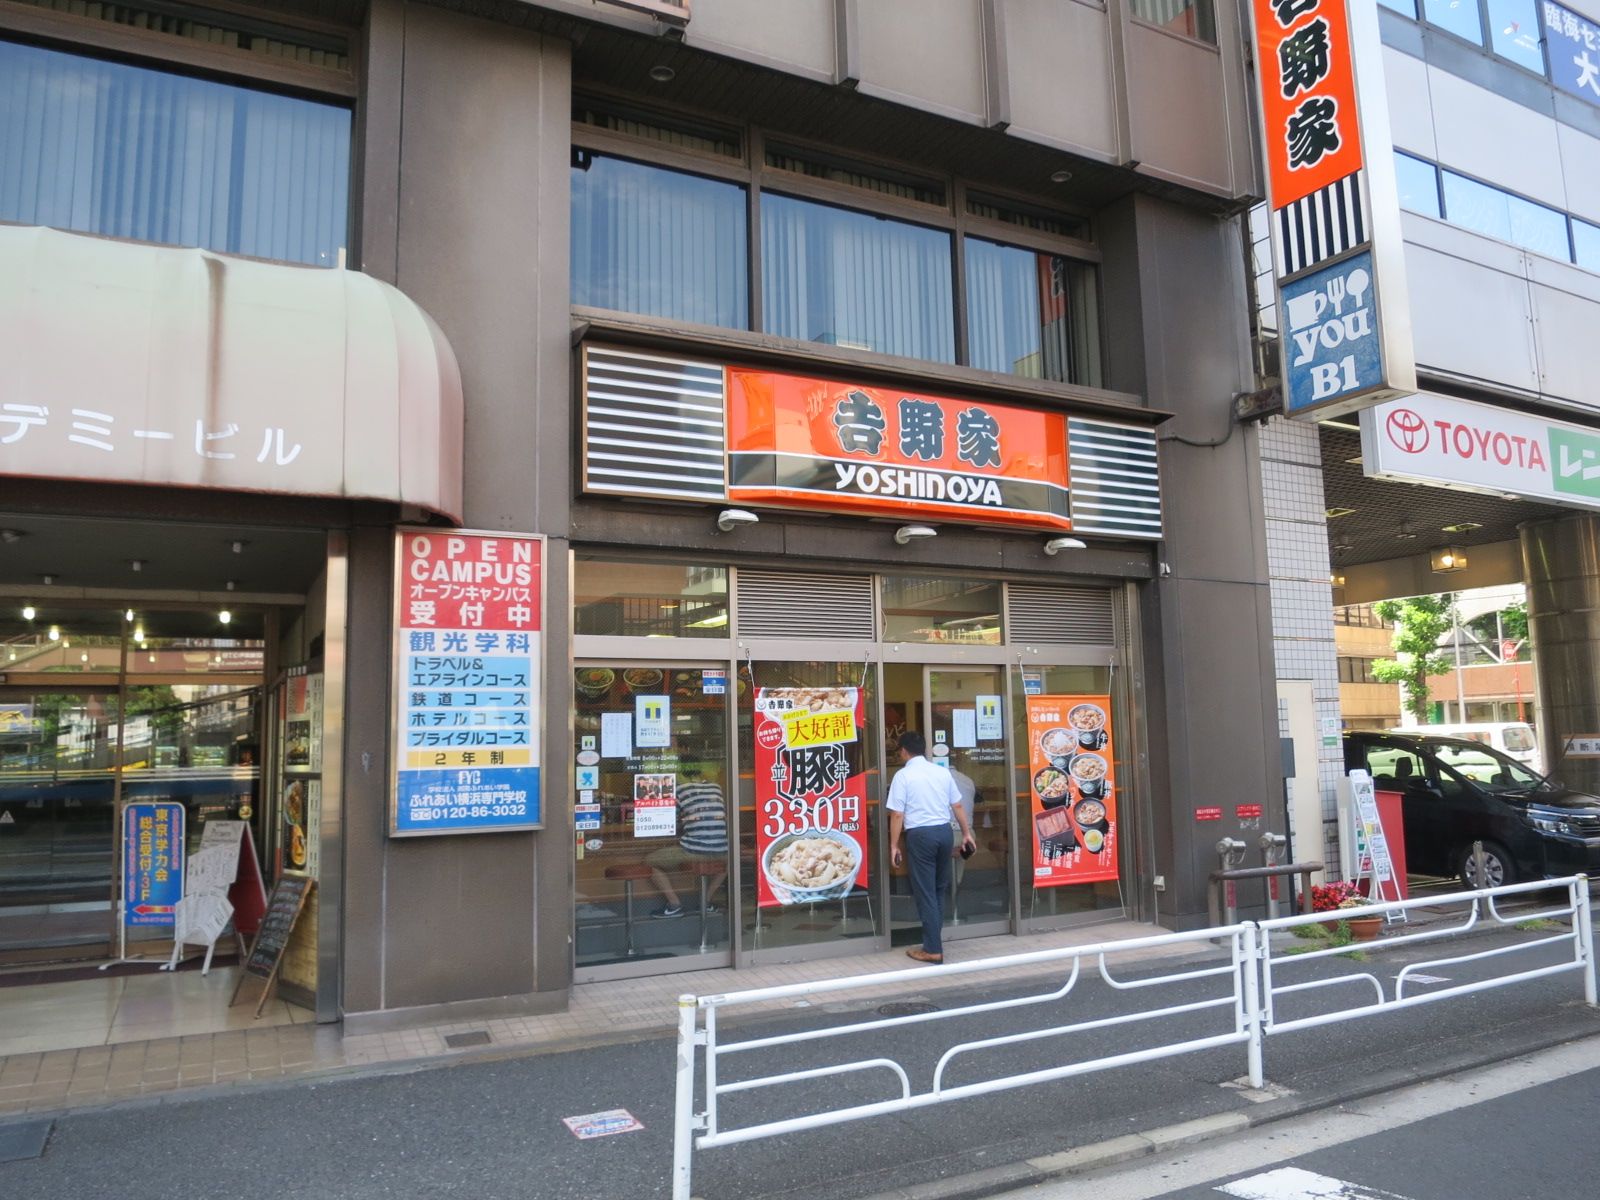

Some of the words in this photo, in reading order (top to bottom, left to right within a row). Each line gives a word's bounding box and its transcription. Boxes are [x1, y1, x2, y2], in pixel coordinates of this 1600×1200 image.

[1543, 0, 1600, 52] 臨海セ
[1292, 307, 1372, 367] you
[1310, 354, 1360, 401] B1
[0, 402, 302, 466] デミービル
[832, 389, 1002, 468] 吉野家
[1433, 420, 1547, 472] TOYOTA
[411, 536, 532, 563] OPEN
[410, 558, 532, 586] CAMPUS
[410, 583, 532, 602] オープンキャンパス
[409, 600, 531, 628] 受付中
[409, 631, 530, 654] 観光学科
[412, 673, 527, 687] エアラインコース
[411, 692, 527, 706] 鉄道コース
[411, 712, 526, 727] ホテルコース
[788, 714, 851, 744] 大好評
[412, 731, 526, 746] ブライダルコース
[434, 751, 504, 765] 2年制
[771, 763, 787, 781] 並
[834, 760, 850, 780] 丼
[432, 804, 526, 819] 0120-86-3032
[763, 795, 860, 838] 330円
